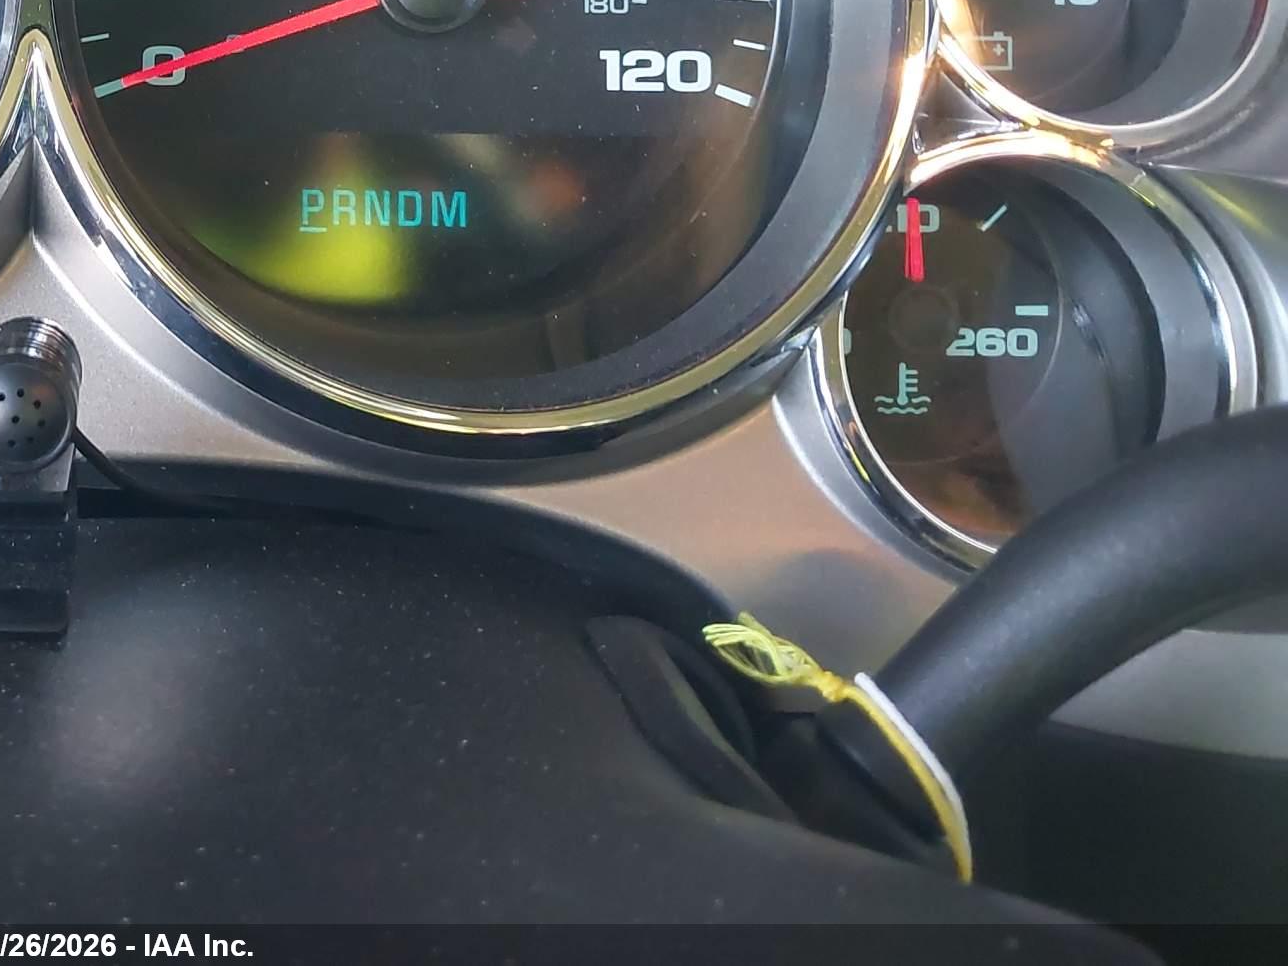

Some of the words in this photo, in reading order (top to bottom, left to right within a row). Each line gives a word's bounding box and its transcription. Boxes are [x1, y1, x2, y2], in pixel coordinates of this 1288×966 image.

[142, 45, 186, 87] 0
[600, 50, 712, 92] 120
[299, 188, 467, 228] PRNDM
[946, 328, 1038, 357] 260
